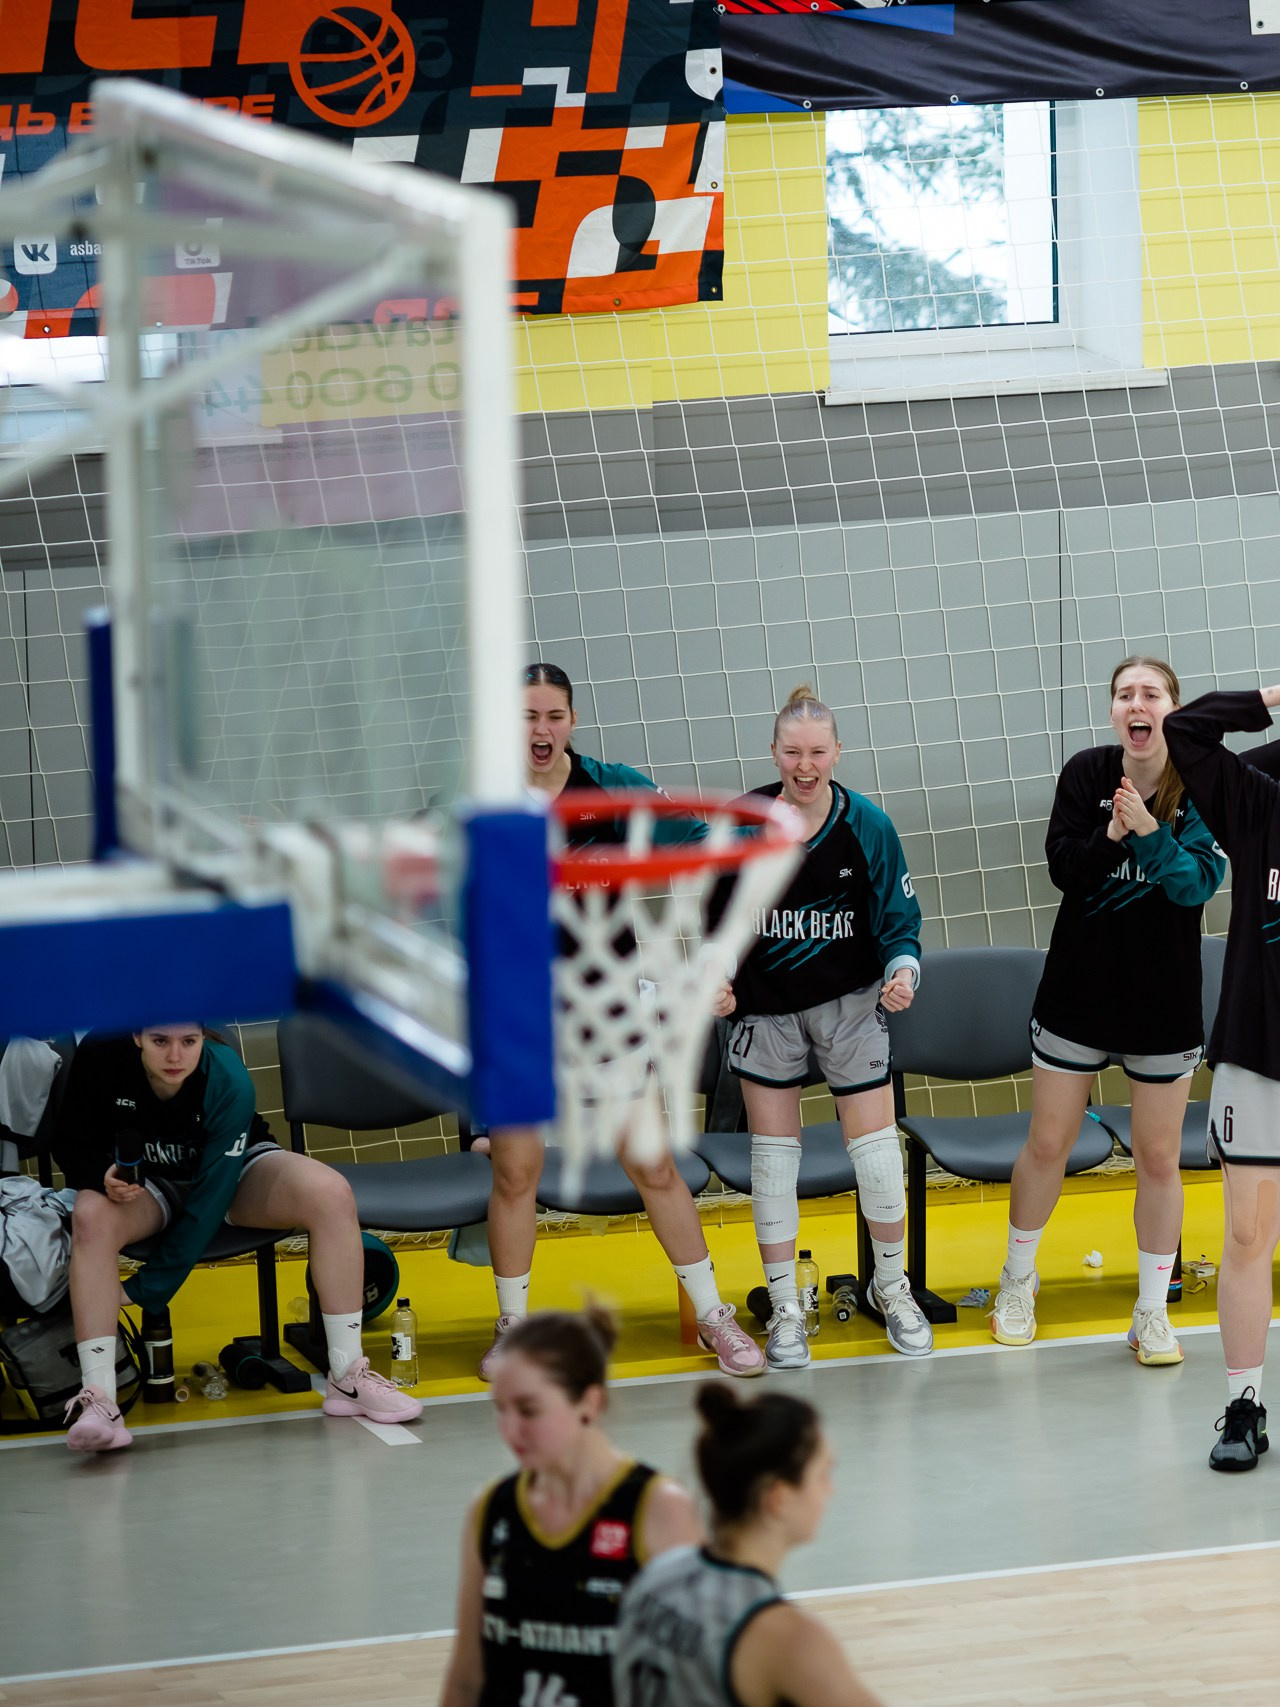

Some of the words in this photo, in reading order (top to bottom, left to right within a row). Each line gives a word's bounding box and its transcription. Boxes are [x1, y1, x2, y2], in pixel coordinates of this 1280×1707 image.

[751, 907, 806, 941] BLACK
[1182, 1051, 1199, 1062] STK
[1223, 1105, 1234, 1144] 6
